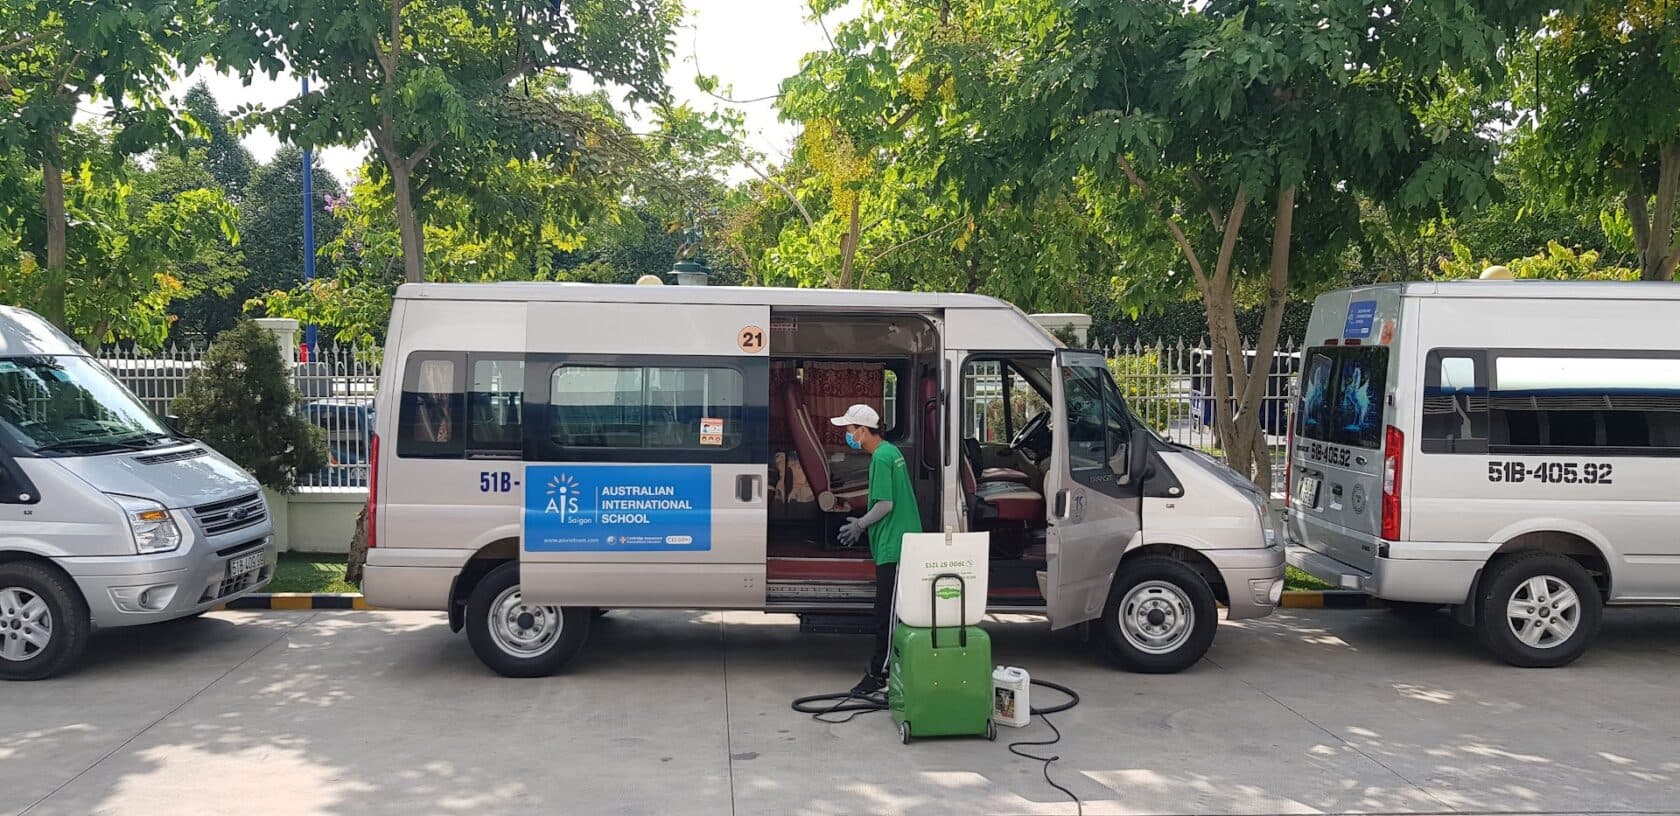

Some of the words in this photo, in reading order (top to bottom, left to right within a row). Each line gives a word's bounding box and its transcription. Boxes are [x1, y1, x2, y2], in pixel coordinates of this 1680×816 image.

[742, 332, 762, 347] 21
[1311, 442, 1351, 467] 51B-405.92
[1488, 461, 1612, 484] 51B-405.92
[602, 486, 674, 496] AUSTRALIAN
[602, 499, 692, 510] INTERNATIONAL
[568, 516, 592, 526] Saigon
[602, 513, 650, 524] SCHOOL
